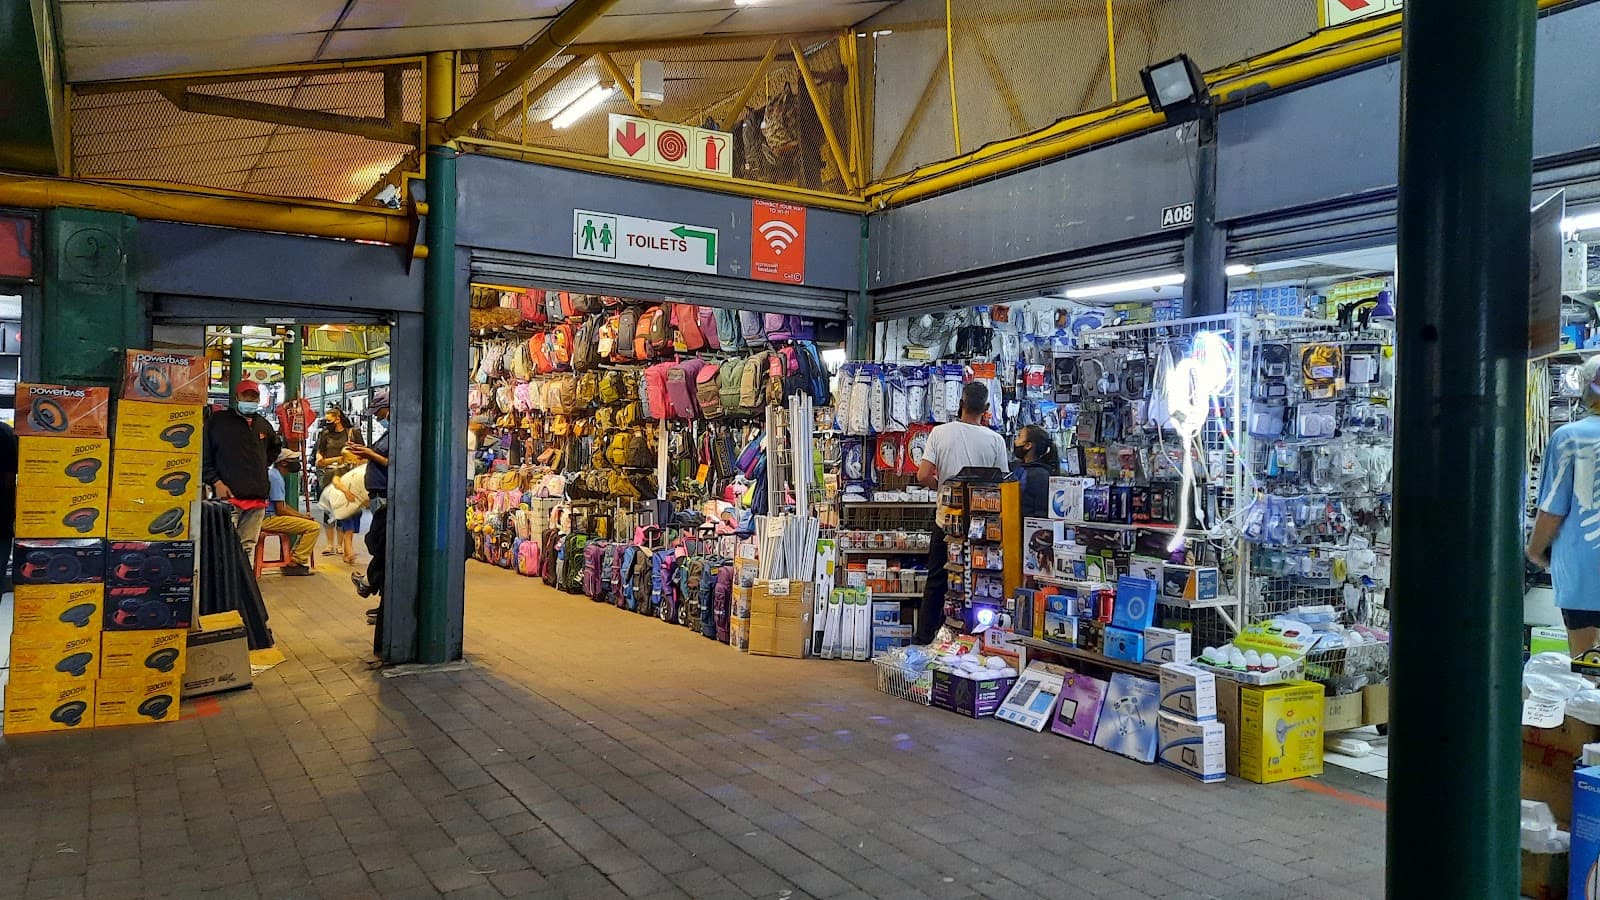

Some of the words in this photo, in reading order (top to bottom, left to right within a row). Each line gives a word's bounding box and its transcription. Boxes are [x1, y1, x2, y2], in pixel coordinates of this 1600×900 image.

[755, 199, 779, 208] CONNECT
[1164, 205, 1192, 225] A08
[626, 234, 687, 253] TOILETS
[963, 538, 973, 609] DURACELL
